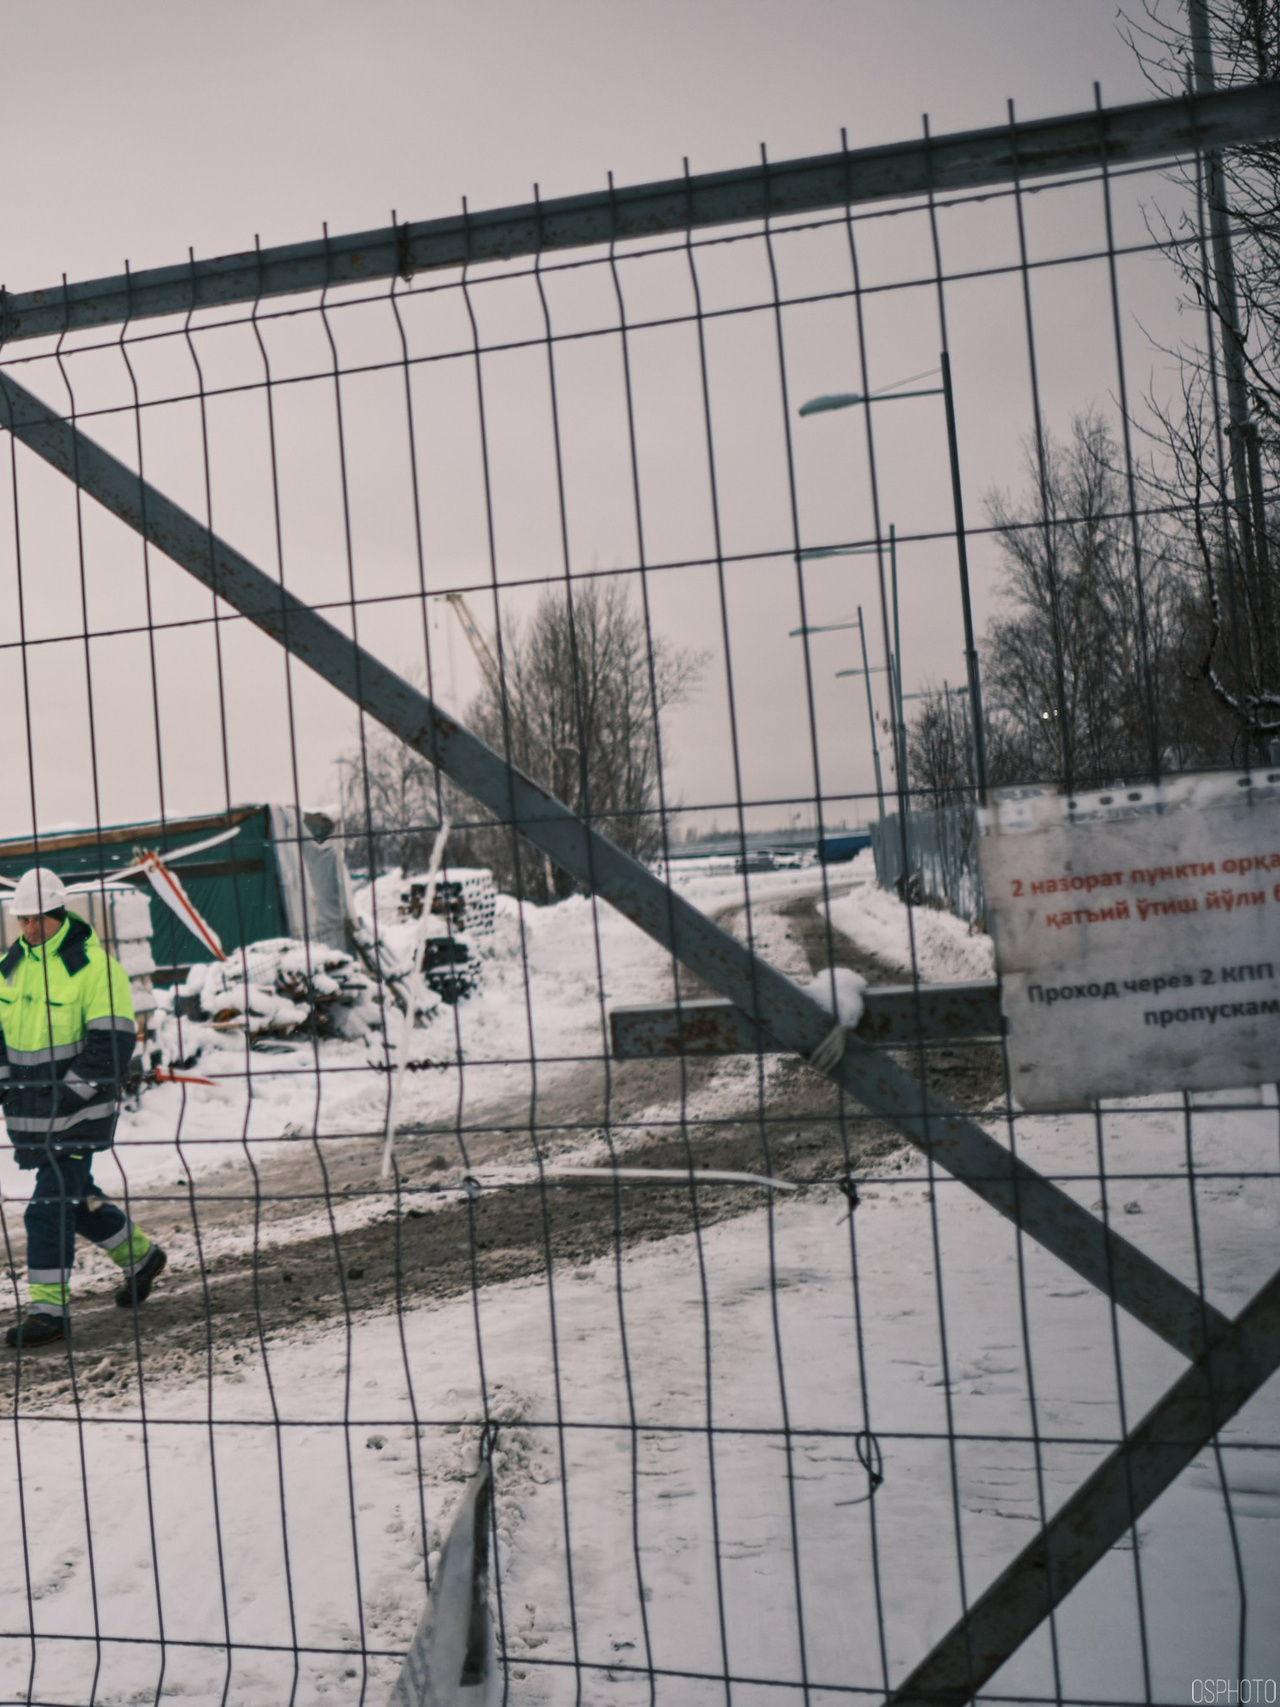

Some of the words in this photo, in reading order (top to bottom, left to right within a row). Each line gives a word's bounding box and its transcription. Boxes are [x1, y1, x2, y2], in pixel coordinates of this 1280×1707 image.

[1010, 879, 1025, 898] 2
[1031, 871, 1124, 896] назорат
[1129, 861, 1216, 887] пункти
[1204, 888, 1267, 913] йўли
[1027, 980, 1119, 1006] Проход
[1123, 973, 1194, 995] через
[1200, 967, 1216, 986] 2
[1221, 961, 1275, 983] КПП
